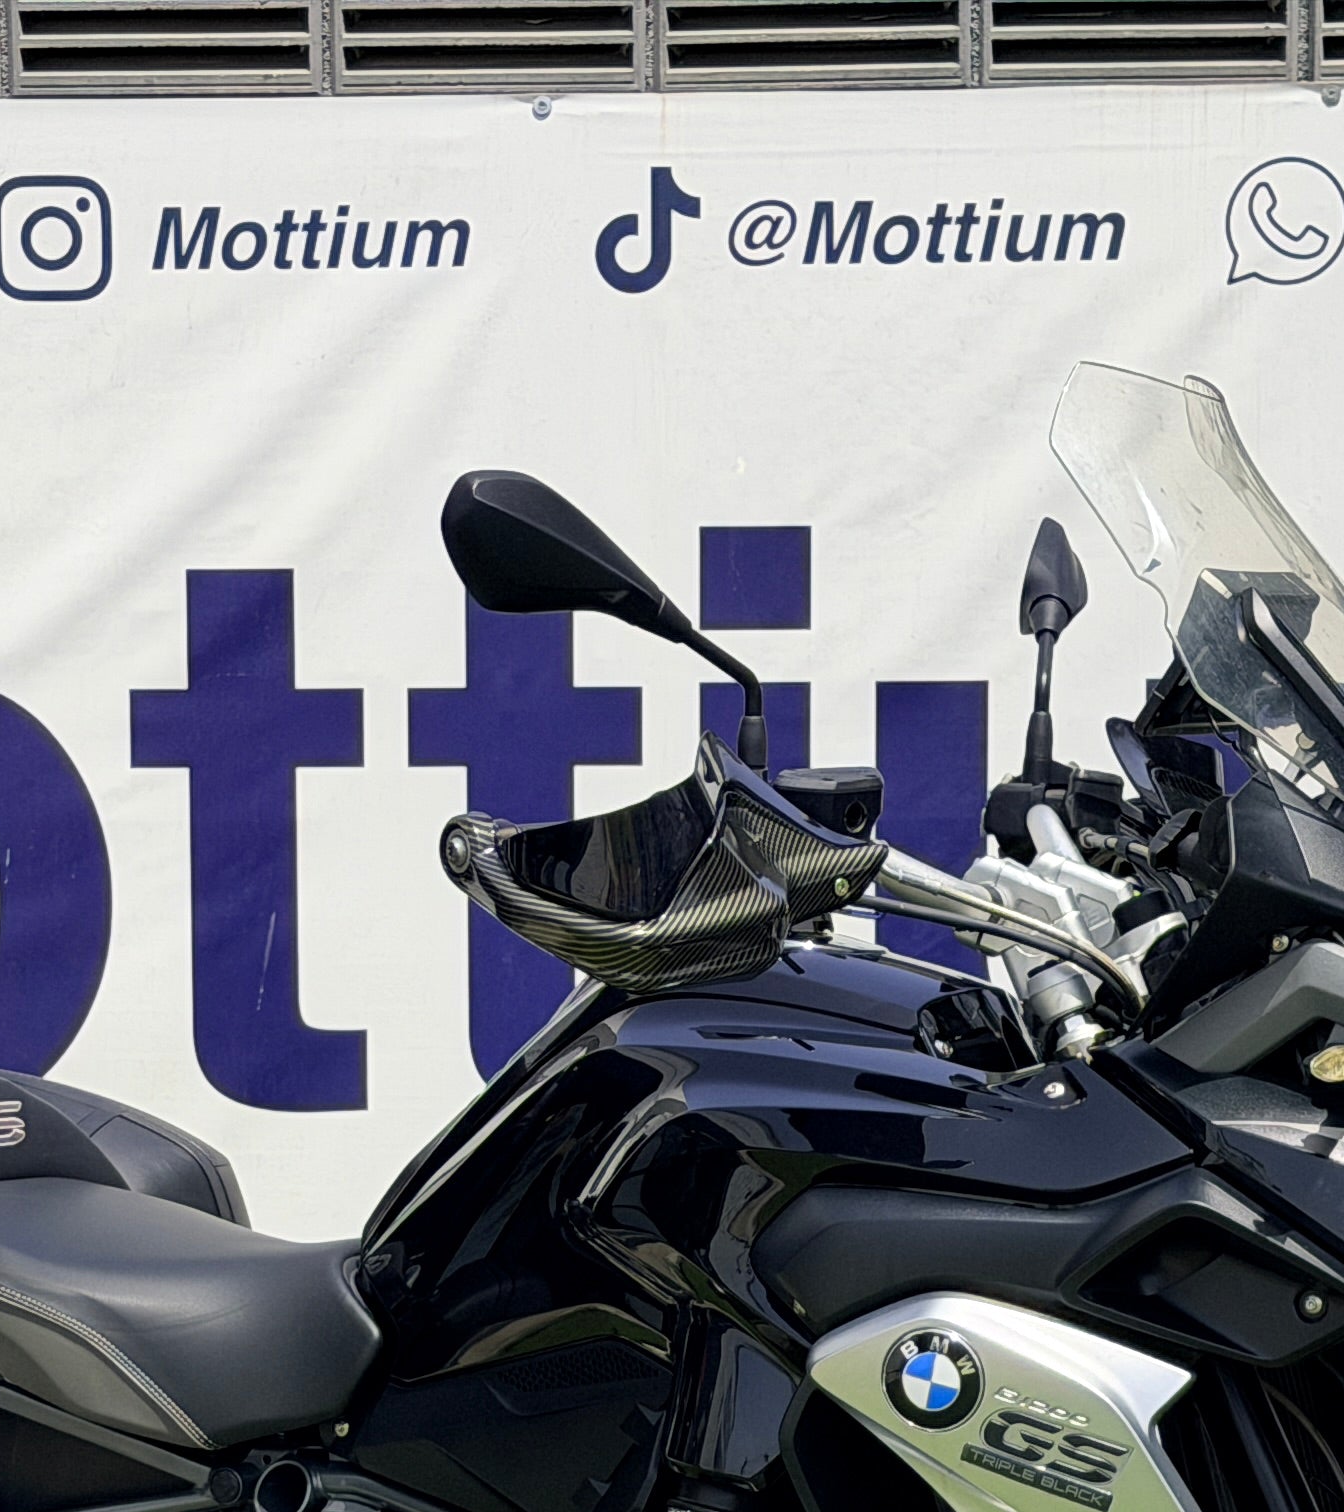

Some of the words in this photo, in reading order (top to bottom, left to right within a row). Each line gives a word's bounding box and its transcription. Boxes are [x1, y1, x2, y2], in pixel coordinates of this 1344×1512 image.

[152, 204, 471, 271] Mottium
[728, 198, 1126, 267] @Mottium
[899, 1335, 976, 1377] BMW
[969, 1450, 1037, 1482] TRIPLE
[1040, 1475, 1106, 1507] BLACK
[981, 1408, 1132, 1485] GS
